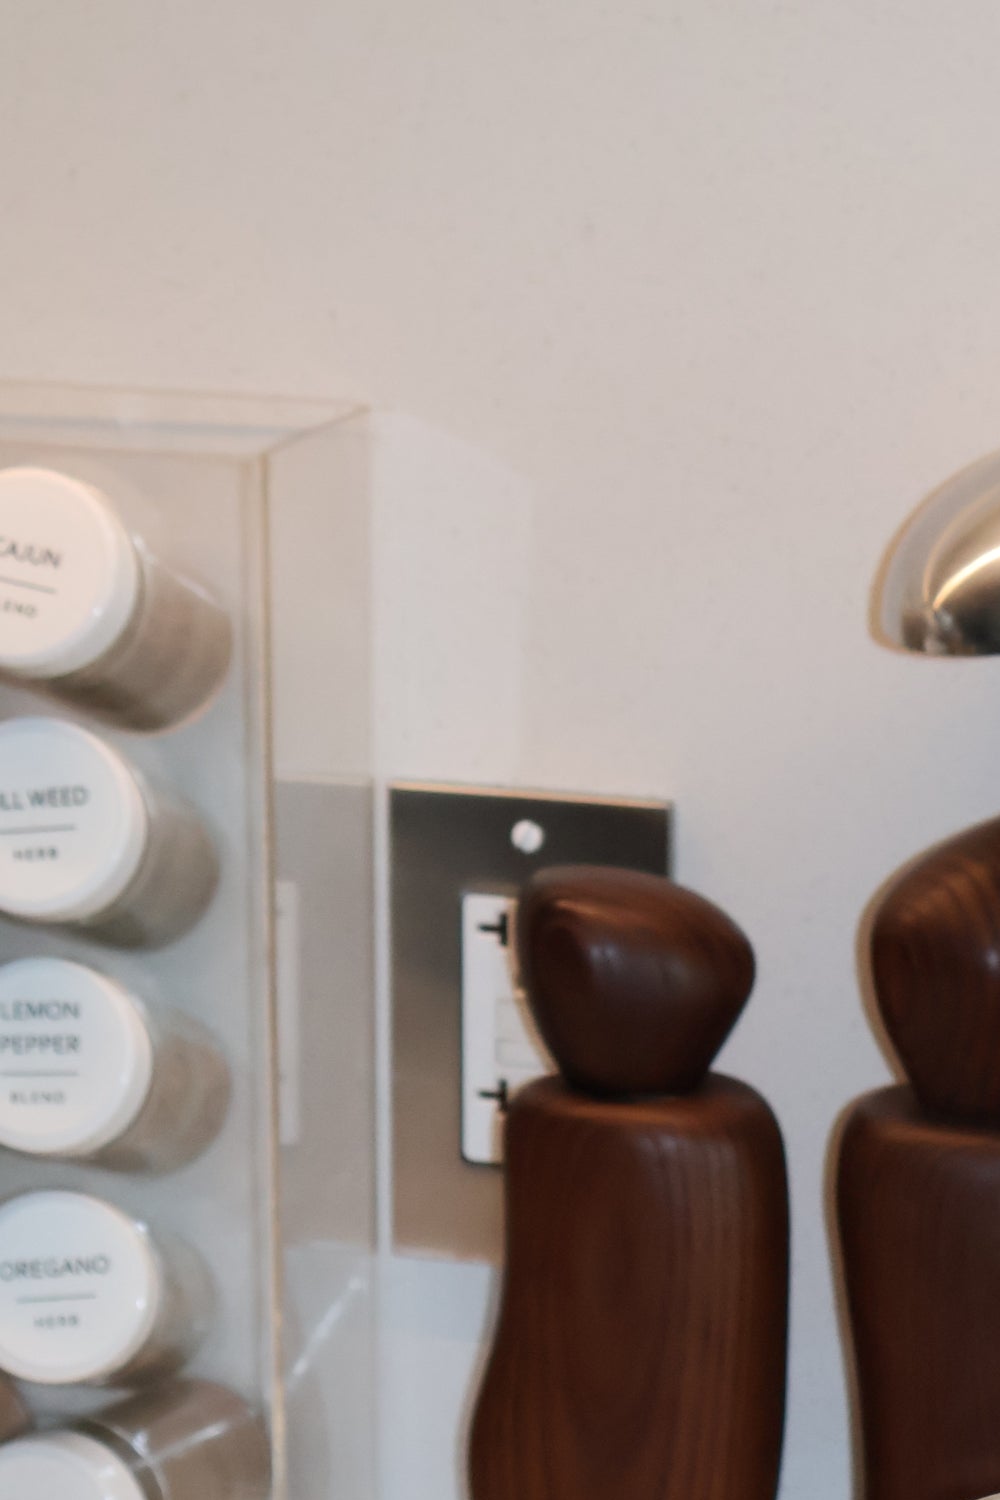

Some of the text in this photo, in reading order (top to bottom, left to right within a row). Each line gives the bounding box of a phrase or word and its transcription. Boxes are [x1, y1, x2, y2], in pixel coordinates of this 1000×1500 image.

[27, 785, 90, 808] WEED
[0, 1001, 80, 1021] LEMON
[0, 1034, 80, 1055] PEPPER
[0, 1254, 109, 1281] OREGANO
